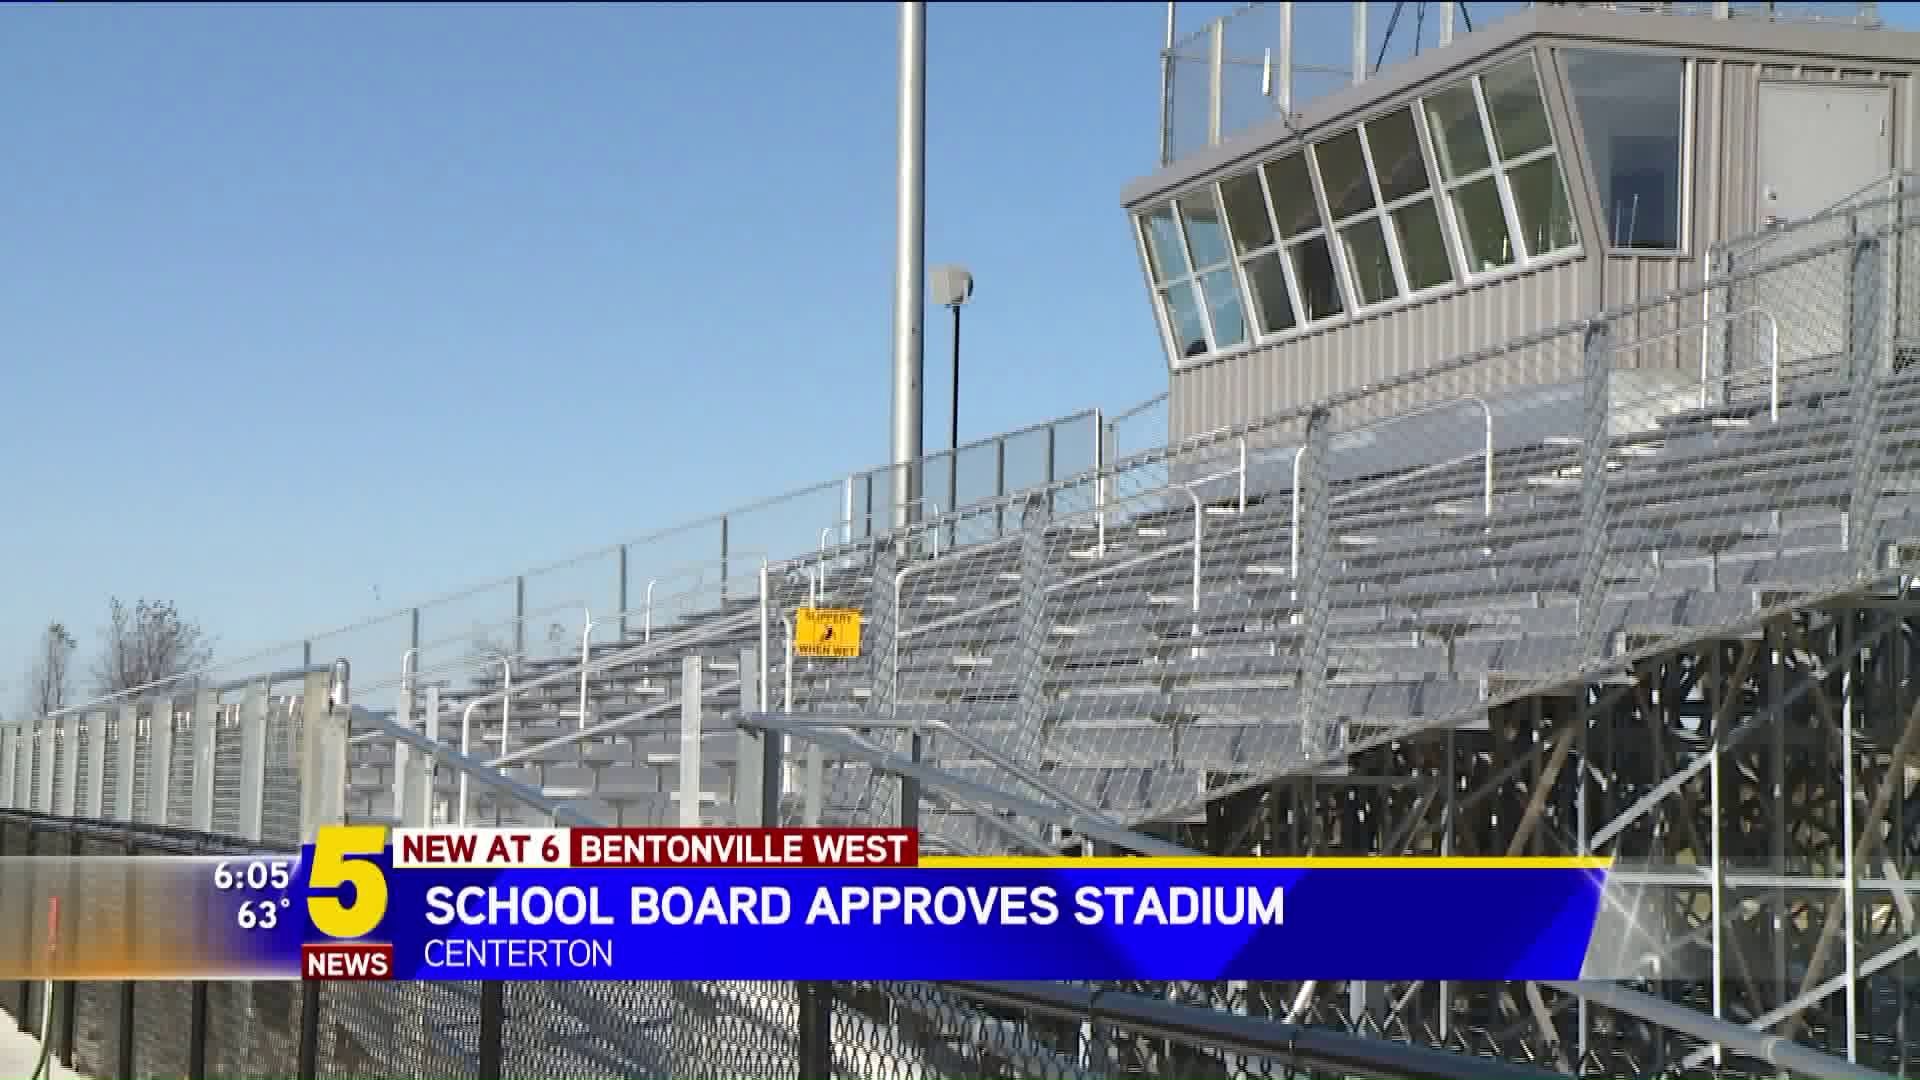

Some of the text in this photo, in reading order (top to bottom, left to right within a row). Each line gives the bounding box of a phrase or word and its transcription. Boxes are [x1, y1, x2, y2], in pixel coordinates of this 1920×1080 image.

[804, 612, 852, 624] SLIPPERY
[799, 645, 857, 656] WHEN WET
